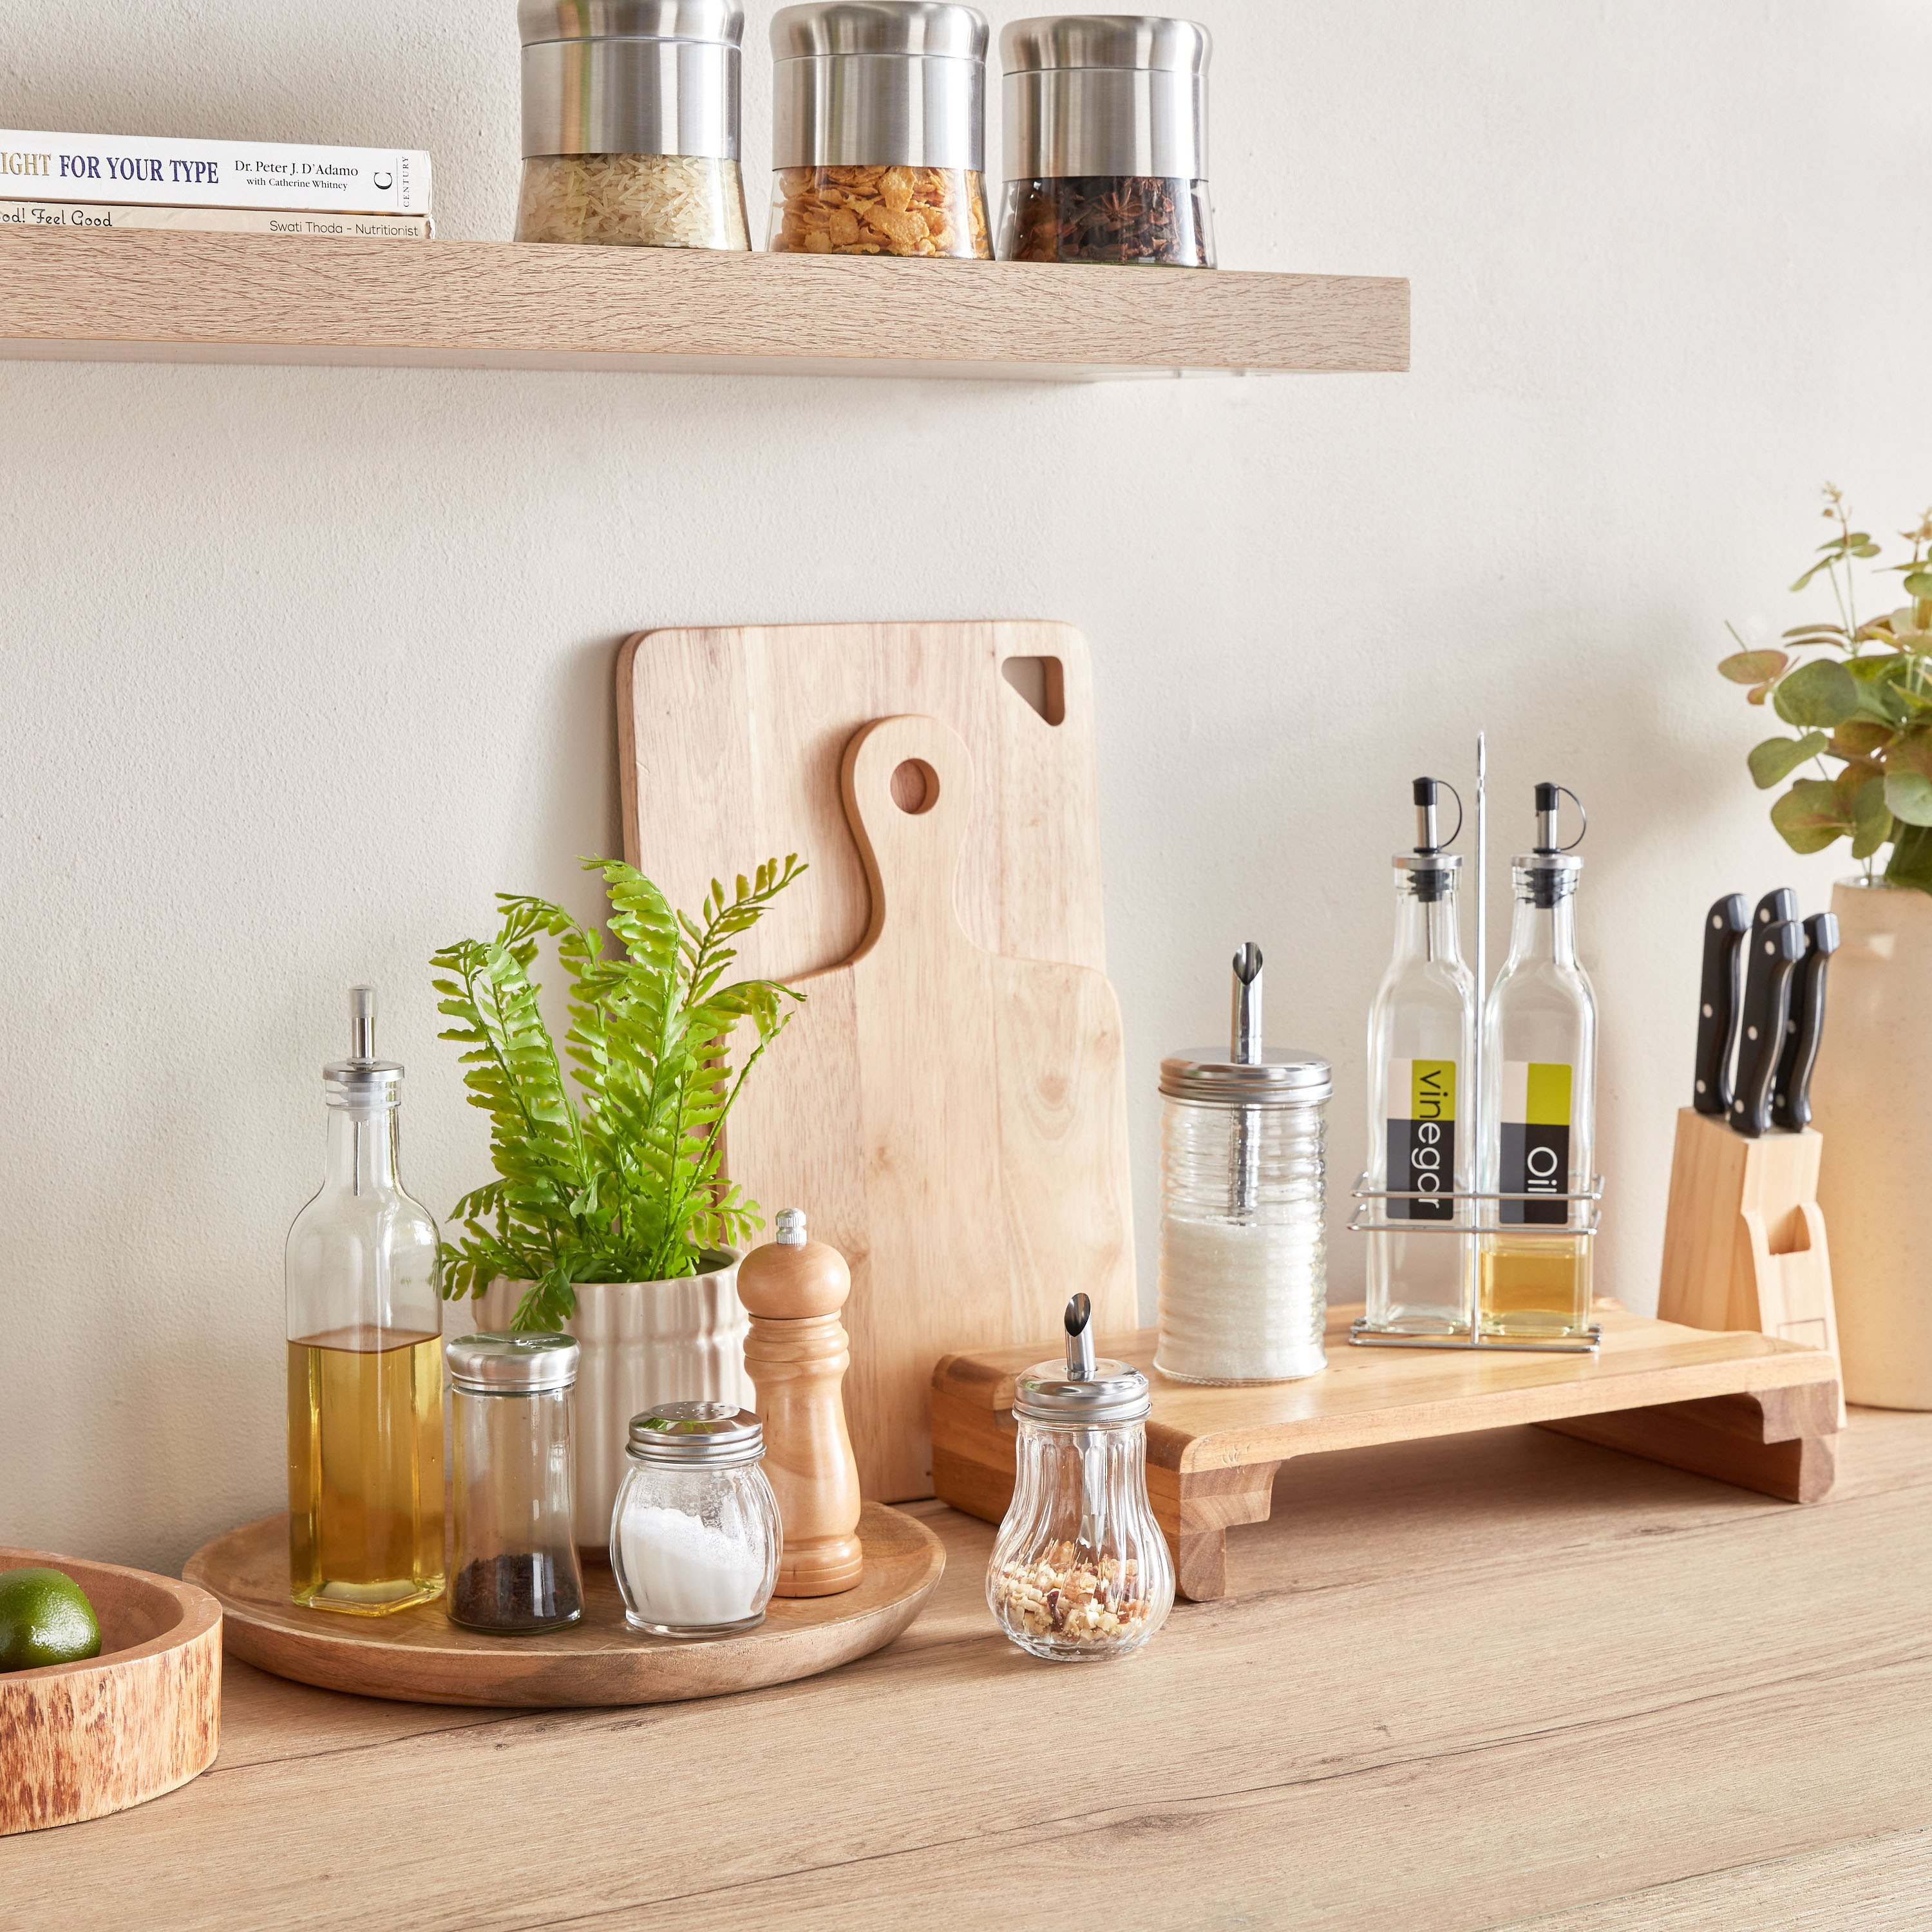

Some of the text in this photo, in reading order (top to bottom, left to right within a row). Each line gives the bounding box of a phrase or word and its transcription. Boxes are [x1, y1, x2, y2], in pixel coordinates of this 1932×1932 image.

[59, 155, 101, 178] FOR
[106, 157, 164, 181] YOUR
[169, 159, 219, 184] TYPE
[235, 160, 358, 176] Dr. Peter J. D'Adamo
[269, 178, 310, 187] Catherine
[312, 180, 348, 191] Whitney
[31, 209, 66, 225] Feel
[71, 210, 113, 226] Good
[270, 220, 301, 232] Swati
[305, 222, 343, 233] Thoda
[355, 224, 419, 236] Nutritionist
[1412, 1070, 1448, 1209] vinegar
[1527, 1146, 1558, 1193] Oil
